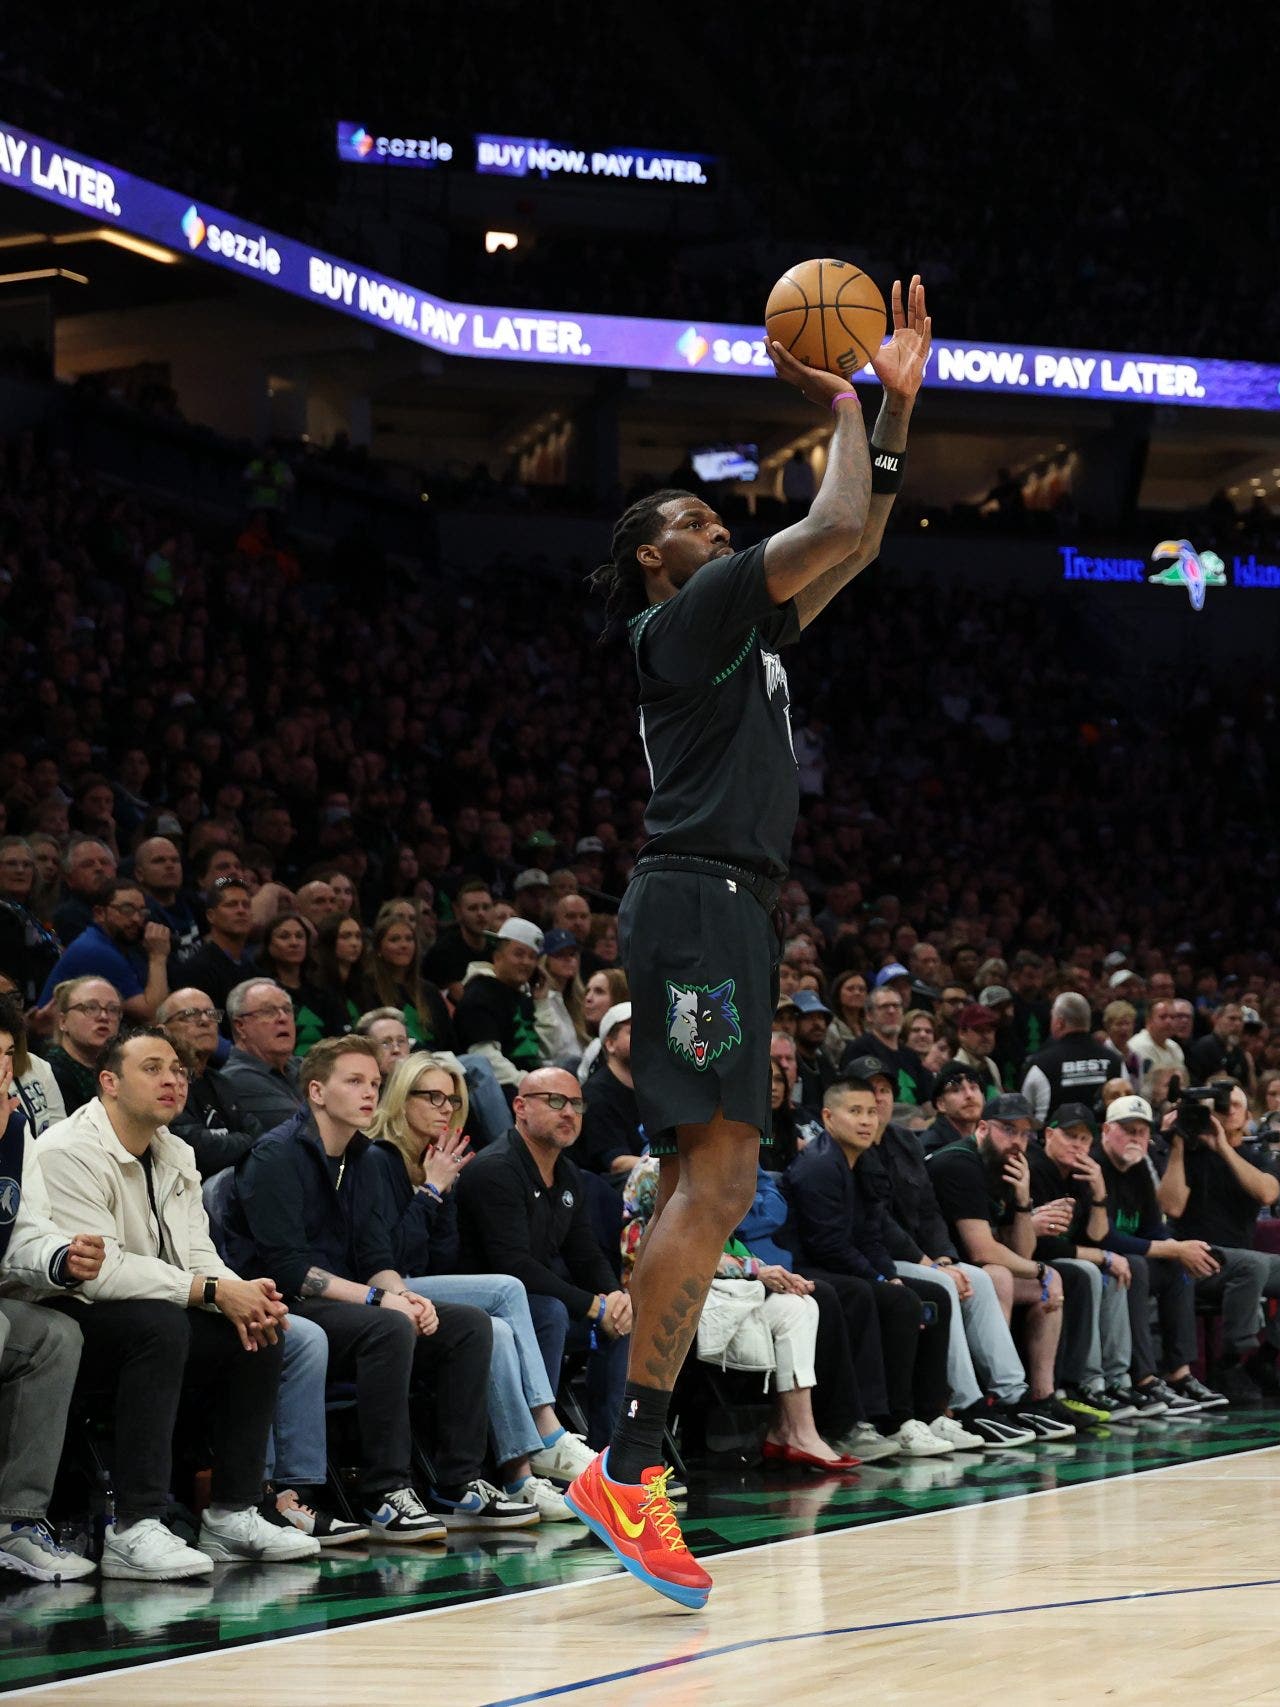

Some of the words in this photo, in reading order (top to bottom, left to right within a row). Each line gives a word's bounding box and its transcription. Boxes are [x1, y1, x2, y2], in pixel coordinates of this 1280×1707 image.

[0, 131, 27, 177] AY
[31, 146, 122, 217] LATER.
[478, 142, 526, 167] BUY
[527, 147, 589, 174] NOW.
[591, 152, 633, 178] PAY
[635, 156, 708, 184] LATER.
[207, 224, 281, 275] sezzle
[309, 256, 357, 305] BUY
[358, 276, 418, 331] NOW.
[420, 301, 466, 345] PAY
[473, 315, 592, 355] LATER.
[938, 347, 1030, 386] NOW.
[1034, 354, 1097, 390] PAY
[1100, 359, 1206, 398] LATER.
[874, 454, 899, 472] TAYP
[1057, 546, 1148, 583] Treasure
[1062, 1059, 1111, 1073] BEST
